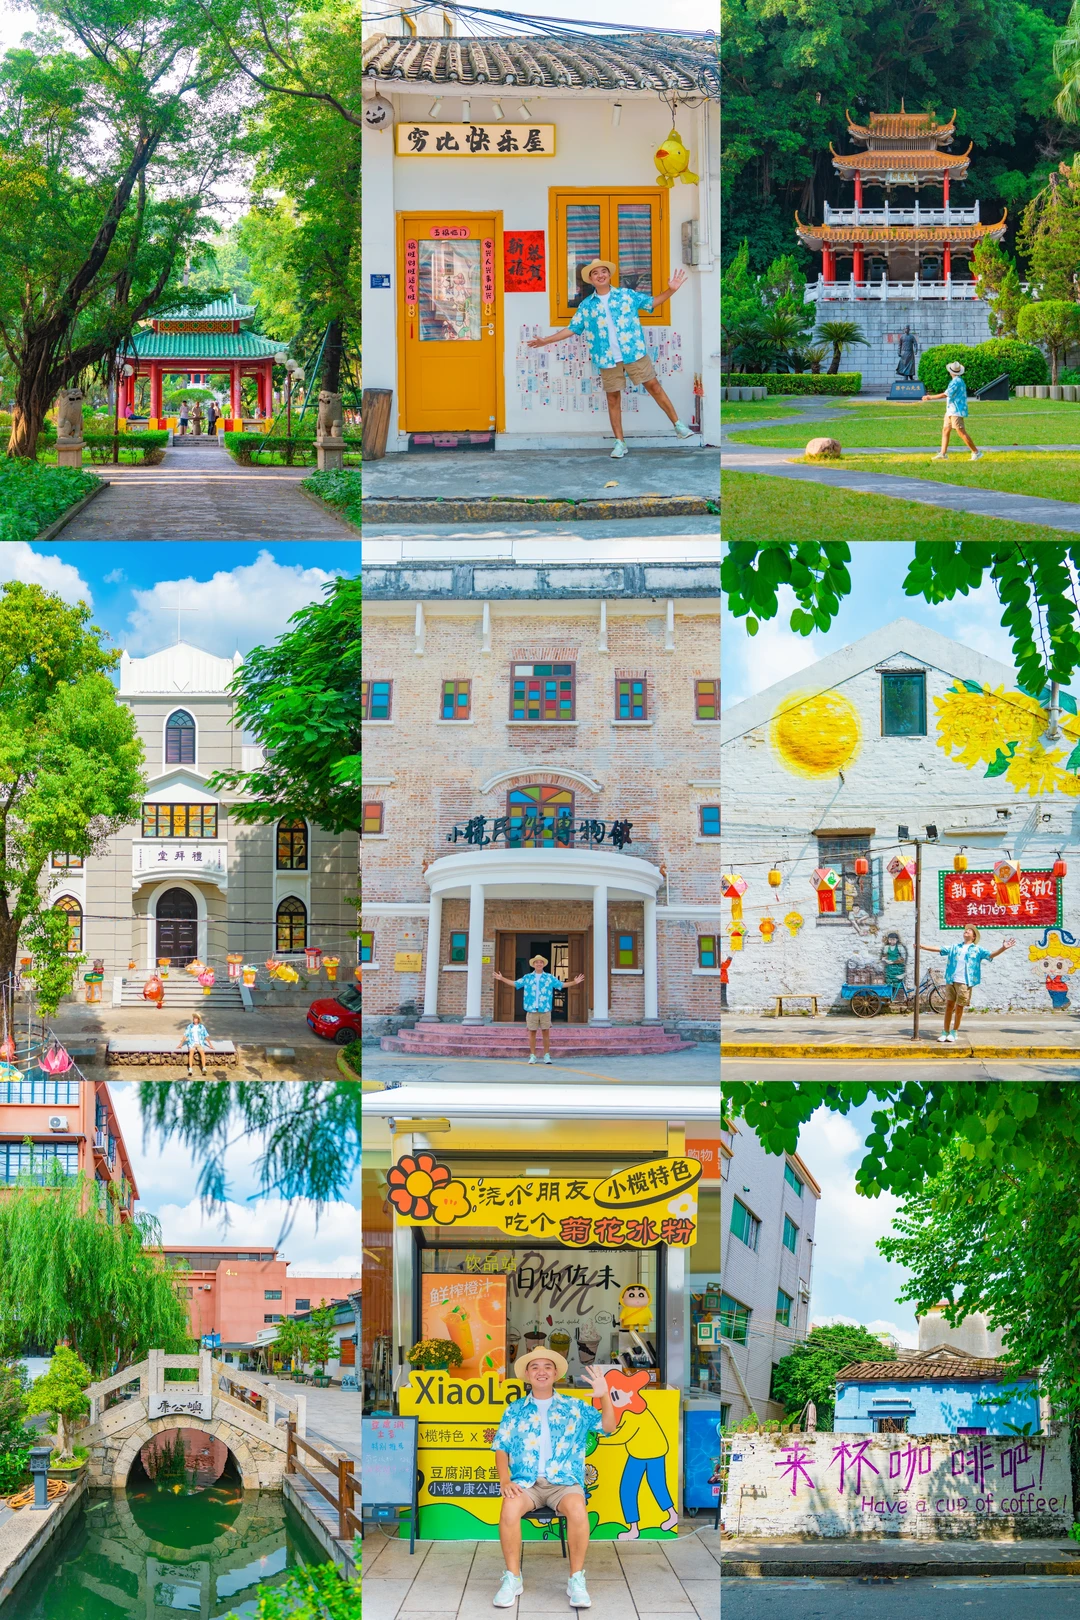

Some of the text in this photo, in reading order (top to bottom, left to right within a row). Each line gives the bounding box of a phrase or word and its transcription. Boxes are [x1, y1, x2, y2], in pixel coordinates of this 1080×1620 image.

[478, 1160, 693, 1206] 浇个朋友 小榄特色
[504, 1212, 696, 1244] 吃个 菊花冰粉
[465, 1254, 518, 1271] 饮品站
[430, 1278, 494, 1307] 鲜榨橙汁
[415, 1376, 528, 1405] XiaoLa
[861, 1496, 908, 1515] Have
[915, 1498, 927, 1513] a
[936, 1496, 968, 1513] cup
[975, 1493, 993, 1514] of
